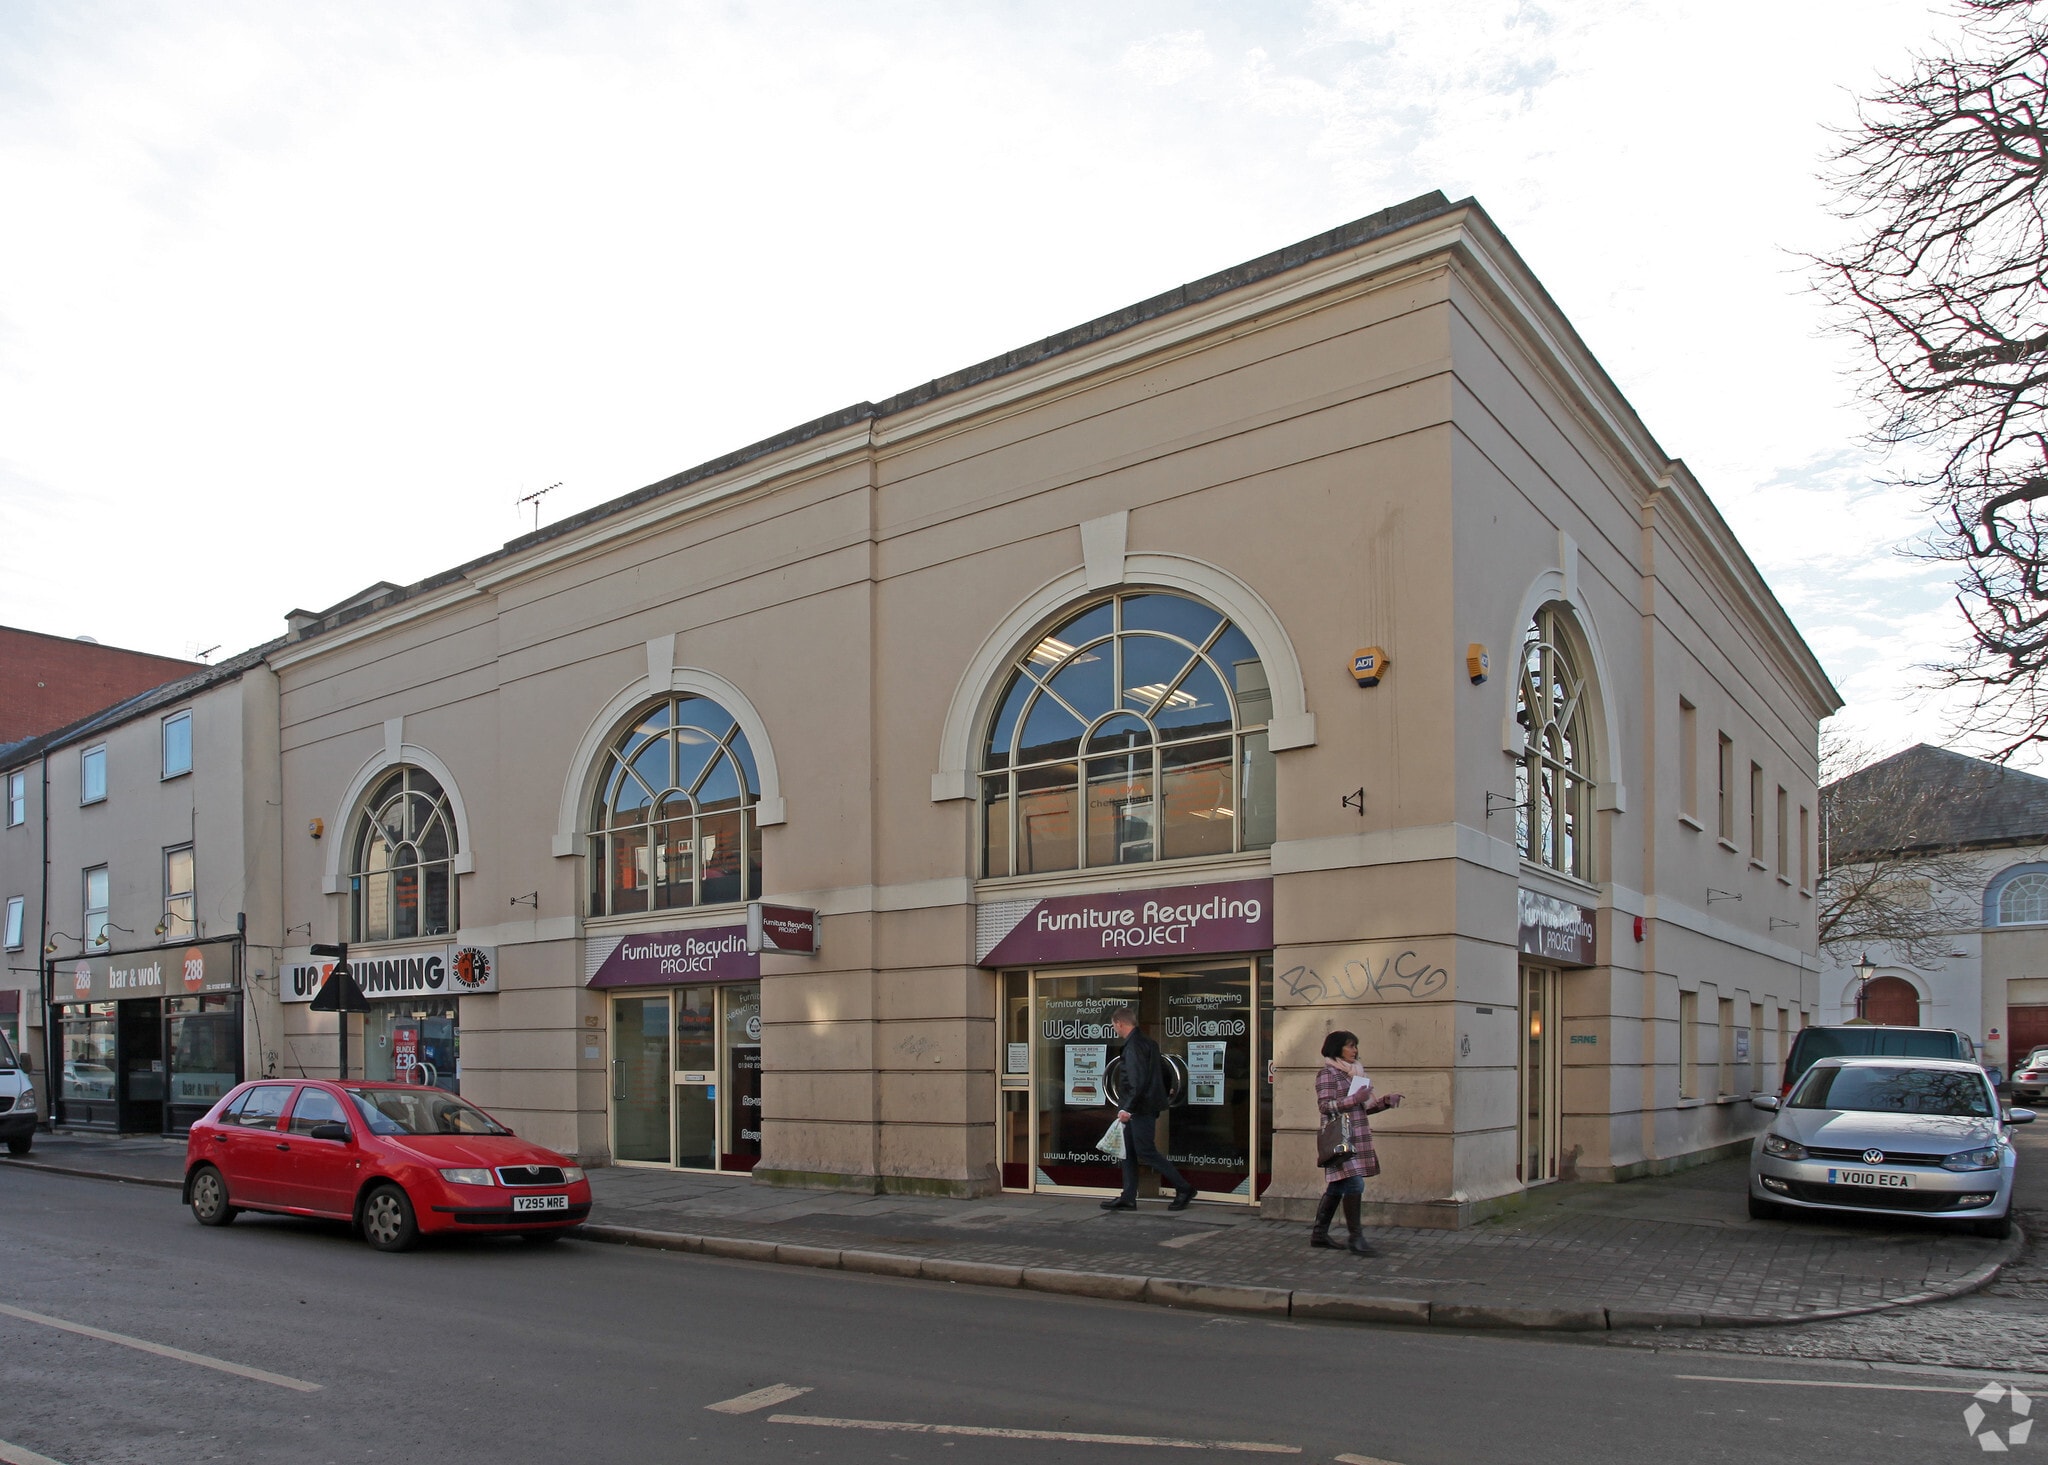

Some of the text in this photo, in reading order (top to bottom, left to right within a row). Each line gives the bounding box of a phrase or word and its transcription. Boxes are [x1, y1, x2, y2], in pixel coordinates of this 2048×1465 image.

[1355, 658, 1375, 669] ADT
[1038, 896, 1261, 931] Furniture Recycling
[1524, 902, 1592, 943] Furniture Recycling
[763, 918, 813, 931] Furniture Recycling
[1102, 924, 1189, 948] PROJECT
[1547, 931, 1574, 953] PROJECT
[622, 940, 682, 960] Furniture
[686, 934, 756, 958] Recyclin
[184, 959, 203, 981] 288
[660, 957, 714, 973] PROJECT
[76, 970, 91, 989] 288
[109, 961, 161, 989] bar & wok
[294, 966, 318, 996] UP
[739, 993, 761, 1003] Furnit
[1046, 998, 1128, 1008] Furniture Recycling
[1169, 992, 1242, 1005] Furniture Recycling
[727, 1003, 760, 1021] Recycling
[1043, 1019, 1119, 1039] Welcom
[1166, 1016, 1245, 1037] Welcome
[396, 1045, 415, 1053] BUNDLE
[396, 1054, 416, 1069] £30
[1166, 1153, 1244, 1168] www.frpglos.org.uk
[1842, 1171, 1909, 1187] VO10 ECA
[518, 1197, 565, 1209] Y295 MRE
